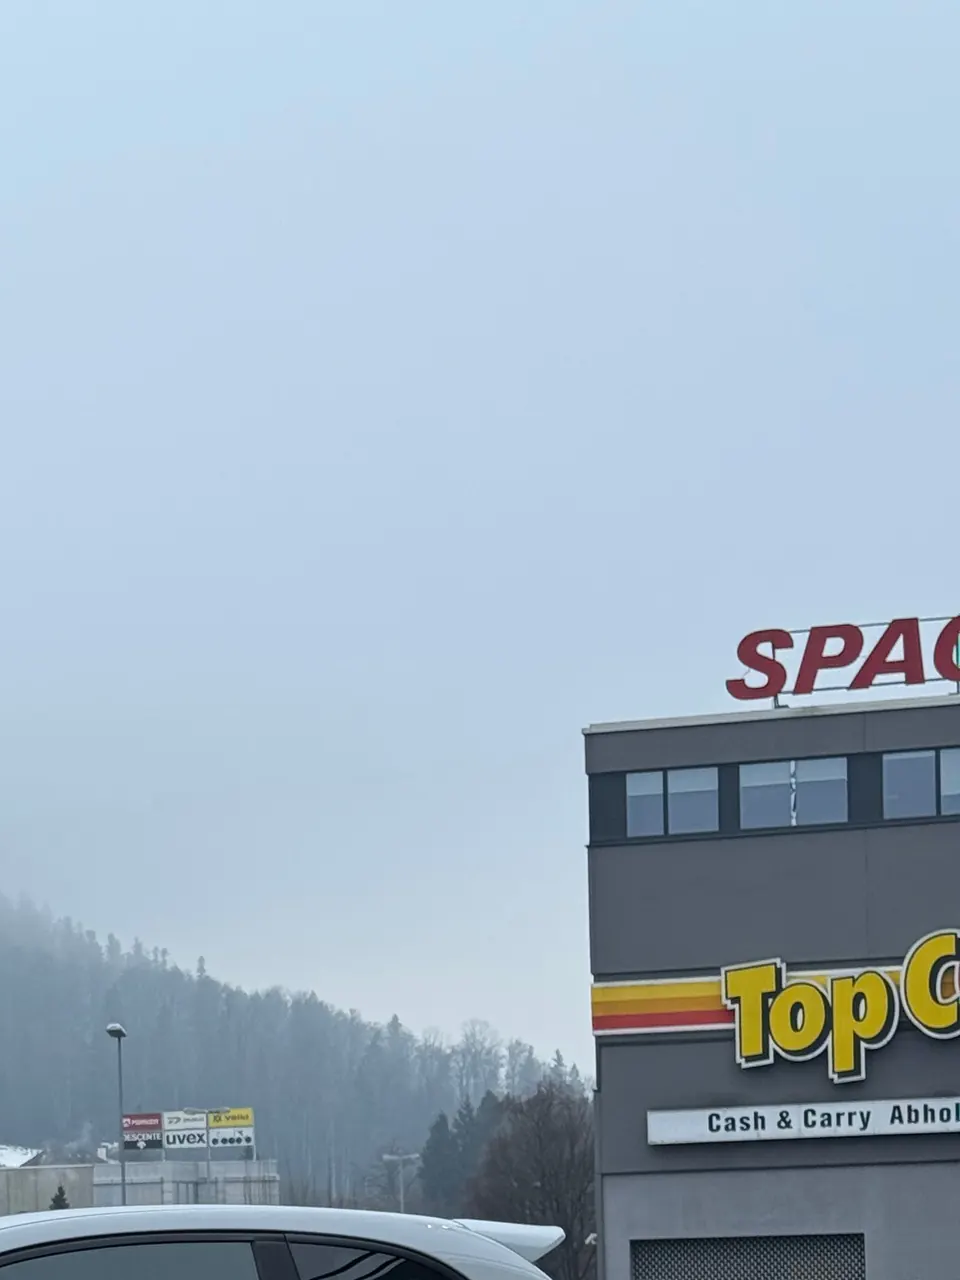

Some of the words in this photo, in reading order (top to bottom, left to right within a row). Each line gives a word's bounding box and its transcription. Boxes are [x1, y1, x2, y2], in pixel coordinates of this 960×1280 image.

[707, 1111, 767, 1133] Cash
[776, 1110, 793, 1130] &
[803, 1107, 872, 1131] Carry
[166, 1133, 206, 1145] uvex
